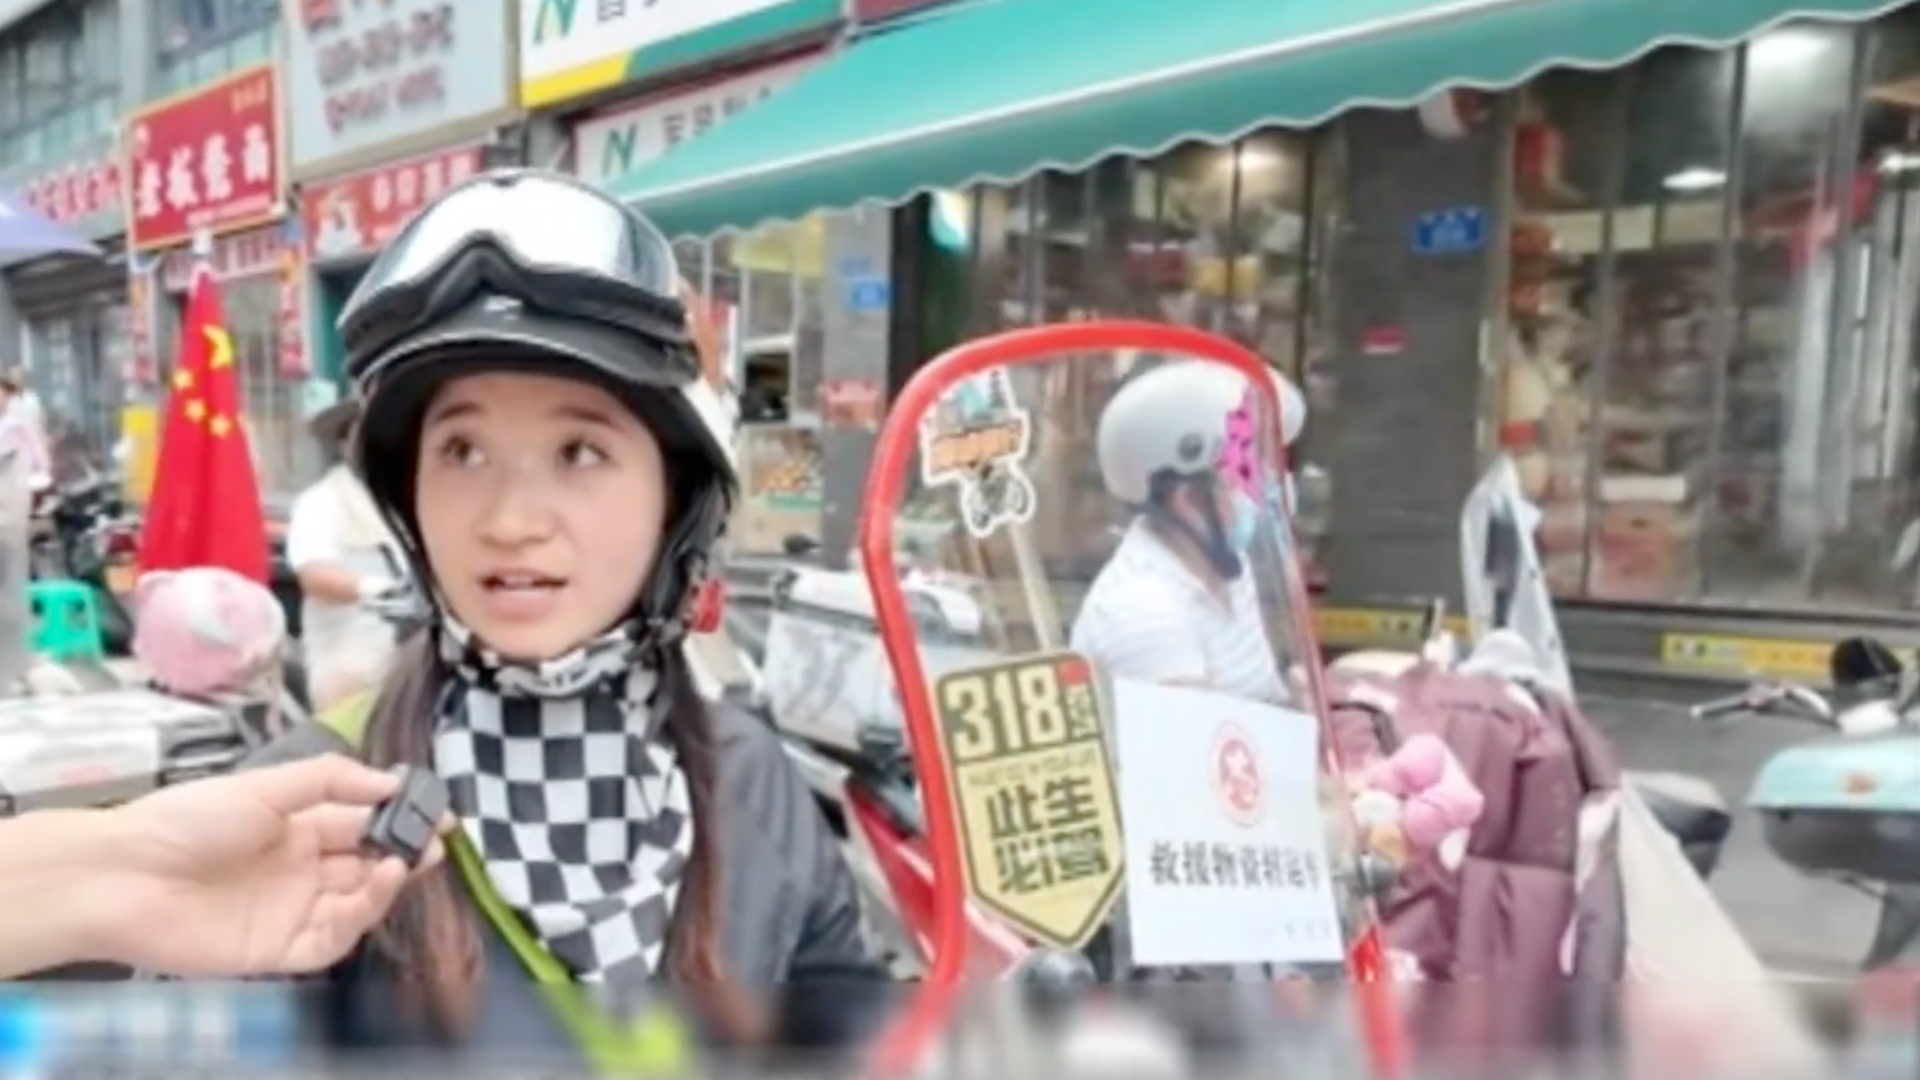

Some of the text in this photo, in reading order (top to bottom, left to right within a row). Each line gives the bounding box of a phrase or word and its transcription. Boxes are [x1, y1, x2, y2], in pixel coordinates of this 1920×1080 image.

[945, 664, 1069, 759] 318
[986, 777, 1100, 838] 此生
[993, 825, 1112, 895] 必驾
